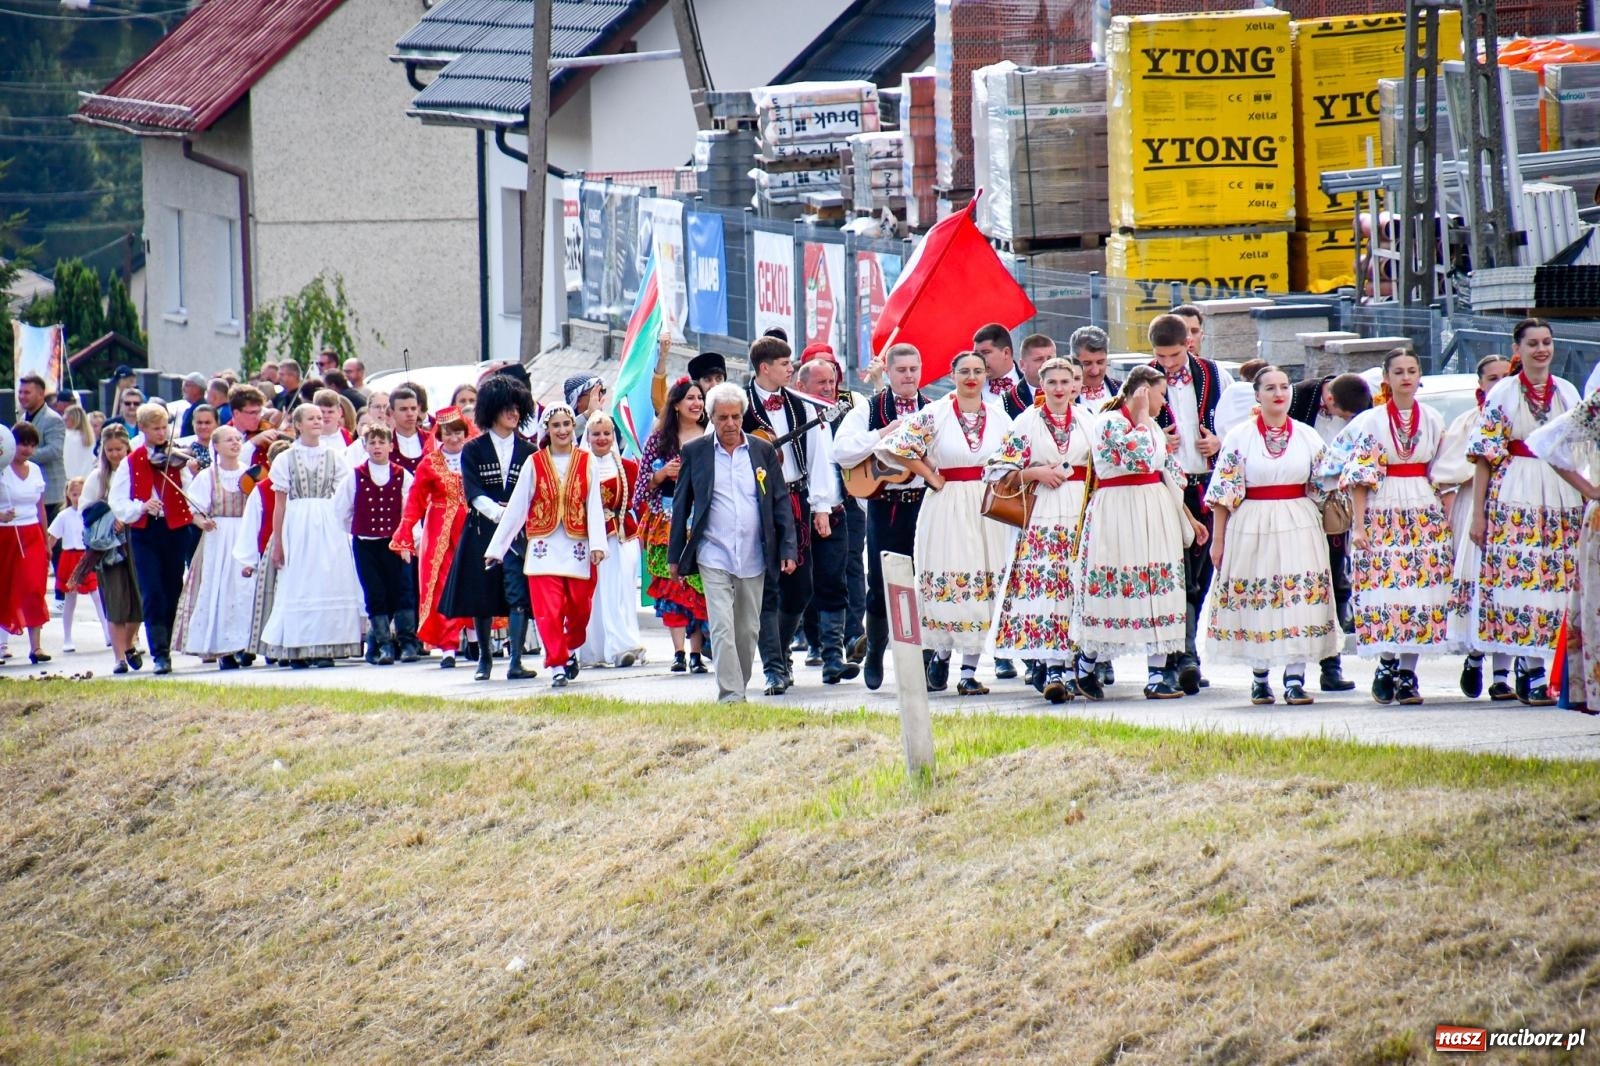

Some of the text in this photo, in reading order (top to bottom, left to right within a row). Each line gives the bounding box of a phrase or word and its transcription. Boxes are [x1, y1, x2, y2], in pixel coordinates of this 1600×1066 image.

[1141, 46, 1275, 74] YTONG
[1313, 89, 1380, 120] YTO
[1142, 136, 1277, 163] YTONG
[757, 260, 791, 316] CEKOL
